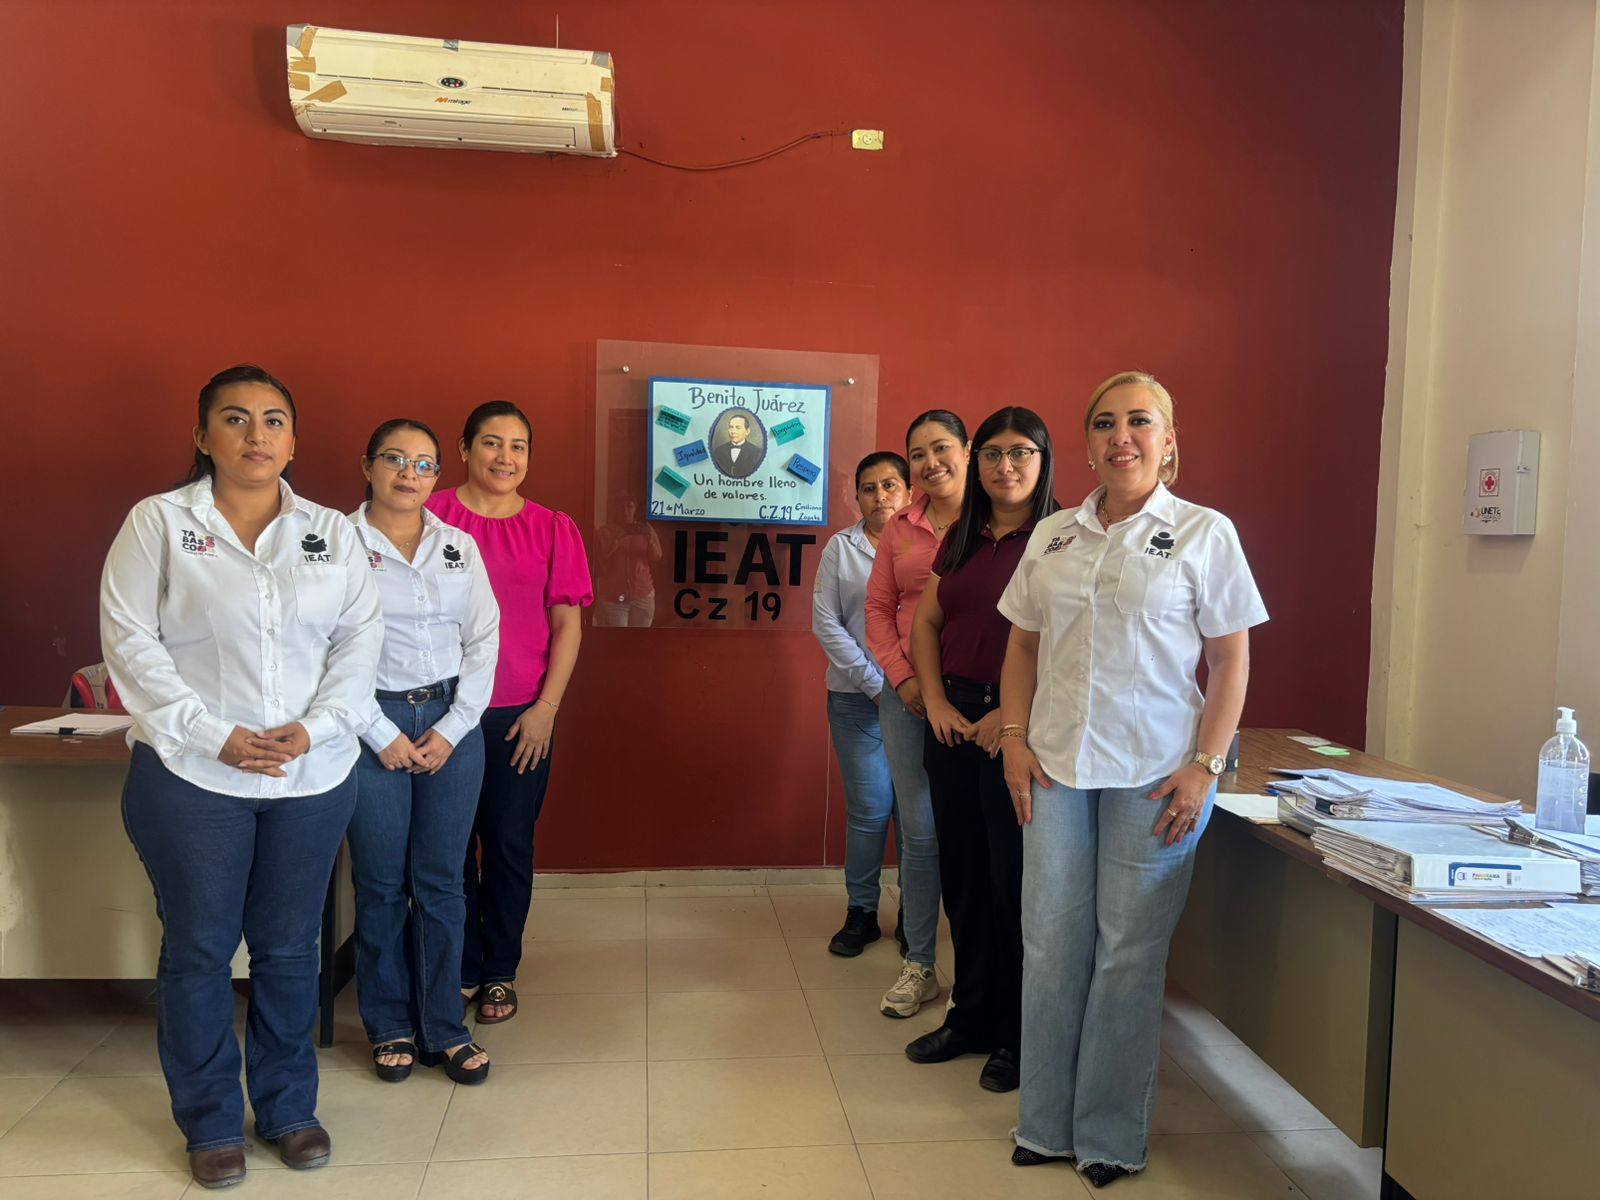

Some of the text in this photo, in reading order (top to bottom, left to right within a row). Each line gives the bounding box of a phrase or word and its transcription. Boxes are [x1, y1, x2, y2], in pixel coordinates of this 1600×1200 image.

[688, 387, 806, 414] Benito Juárez
[693, 473, 714, 486] Un
[718, 474, 764, 488] hombre
[769, 476, 797, 488] lleno
[704, 489, 767, 501] de valores.
[652, 501, 665, 515] 21
[673, 503, 705, 515] Marzo
[304, 554, 331, 562] IEAT
[673, 530, 817, 586] IEAT
[1144, 547, 1172, 559] IEAT
[744, 590, 782, 621] 19
